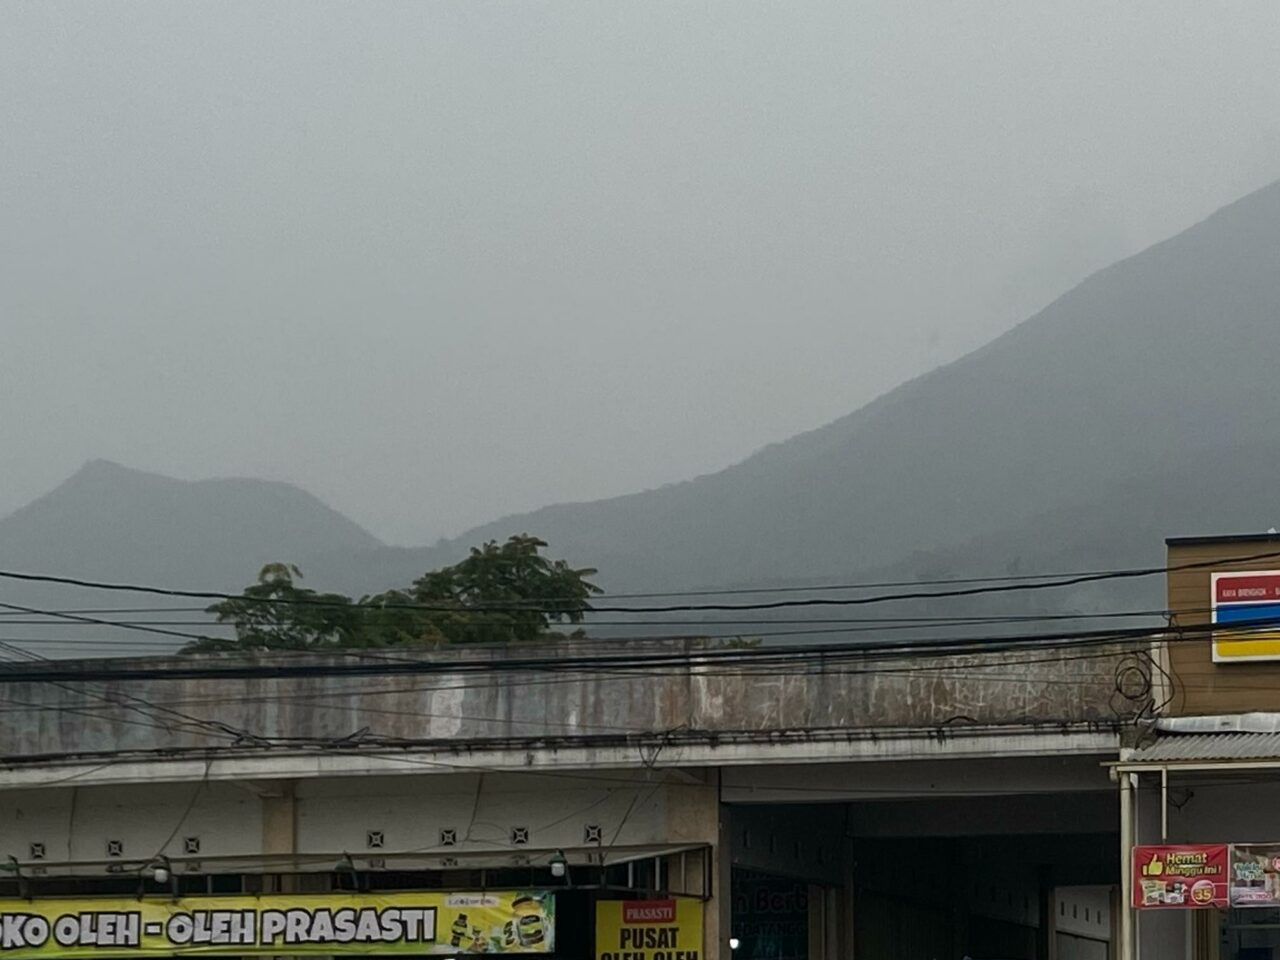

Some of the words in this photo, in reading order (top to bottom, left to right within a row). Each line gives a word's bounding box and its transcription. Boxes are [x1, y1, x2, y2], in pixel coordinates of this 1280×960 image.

[1166, 852, 1208, 864] Hemat
[1166, 864, 1203, 876] Minggu
[626, 907, 673, 920] PRASASTI
[0, 912, 50, 949] KO
[54, 910, 141, 947] OLEH
[167, 908, 257, 945] OLEH
[261, 906, 437, 945] PRASASTI
[620, 928, 680, 949] PUSAT
